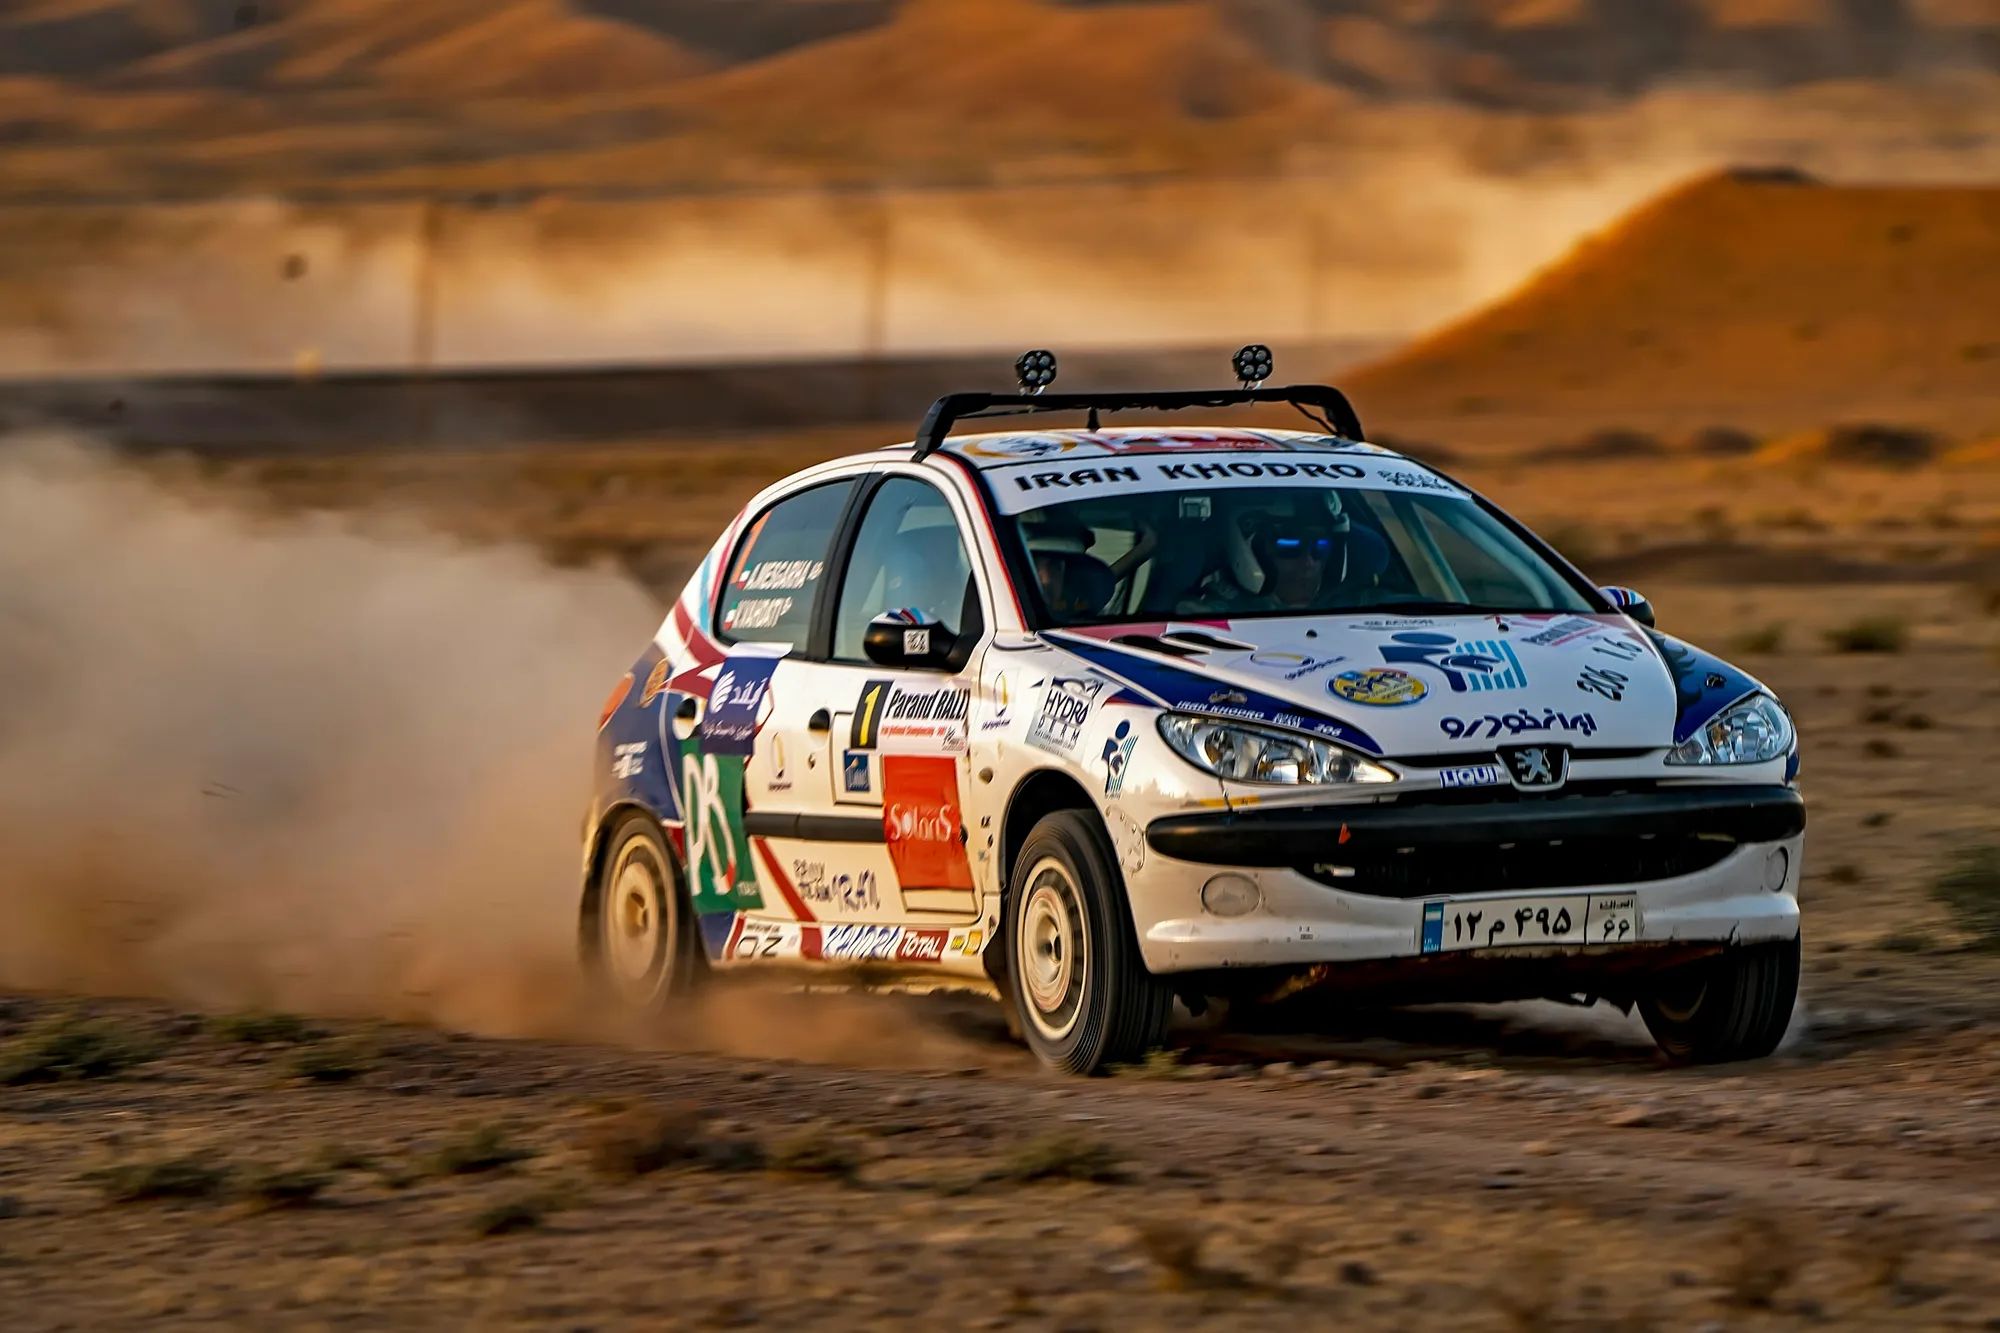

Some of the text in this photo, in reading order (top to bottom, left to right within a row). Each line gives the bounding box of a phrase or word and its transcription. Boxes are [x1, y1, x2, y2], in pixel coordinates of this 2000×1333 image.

[1014, 461, 1367, 491] IRAN KHODRO
[1576, 664, 1630, 702] 206
[859, 684, 882, 747] 1
[885, 688, 940, 719] Parand
[1043, 689, 1090, 727] HYDRO
[1442, 767, 1497, 788] LIQUI
[902, 931, 943, 958] TOTAL
